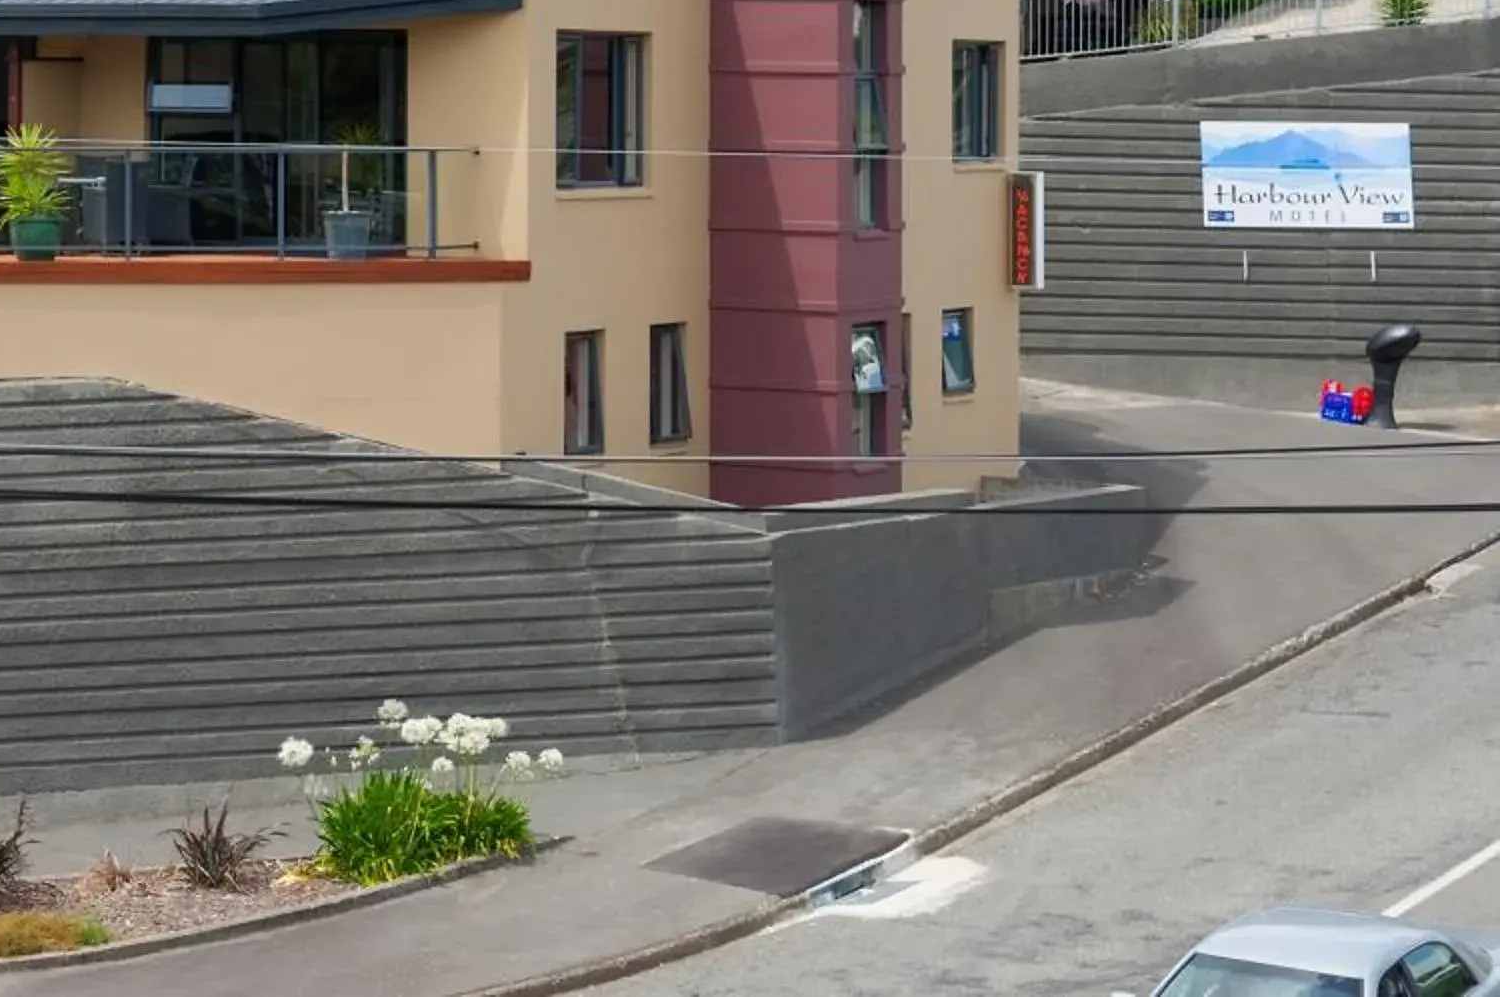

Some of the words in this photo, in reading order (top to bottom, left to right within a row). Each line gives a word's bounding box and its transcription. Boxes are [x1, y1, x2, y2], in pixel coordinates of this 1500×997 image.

[1214, 182, 1331, 205] Harbour
[1337, 183, 1405, 205] View
[1268, 209, 1348, 224] MOTEL
